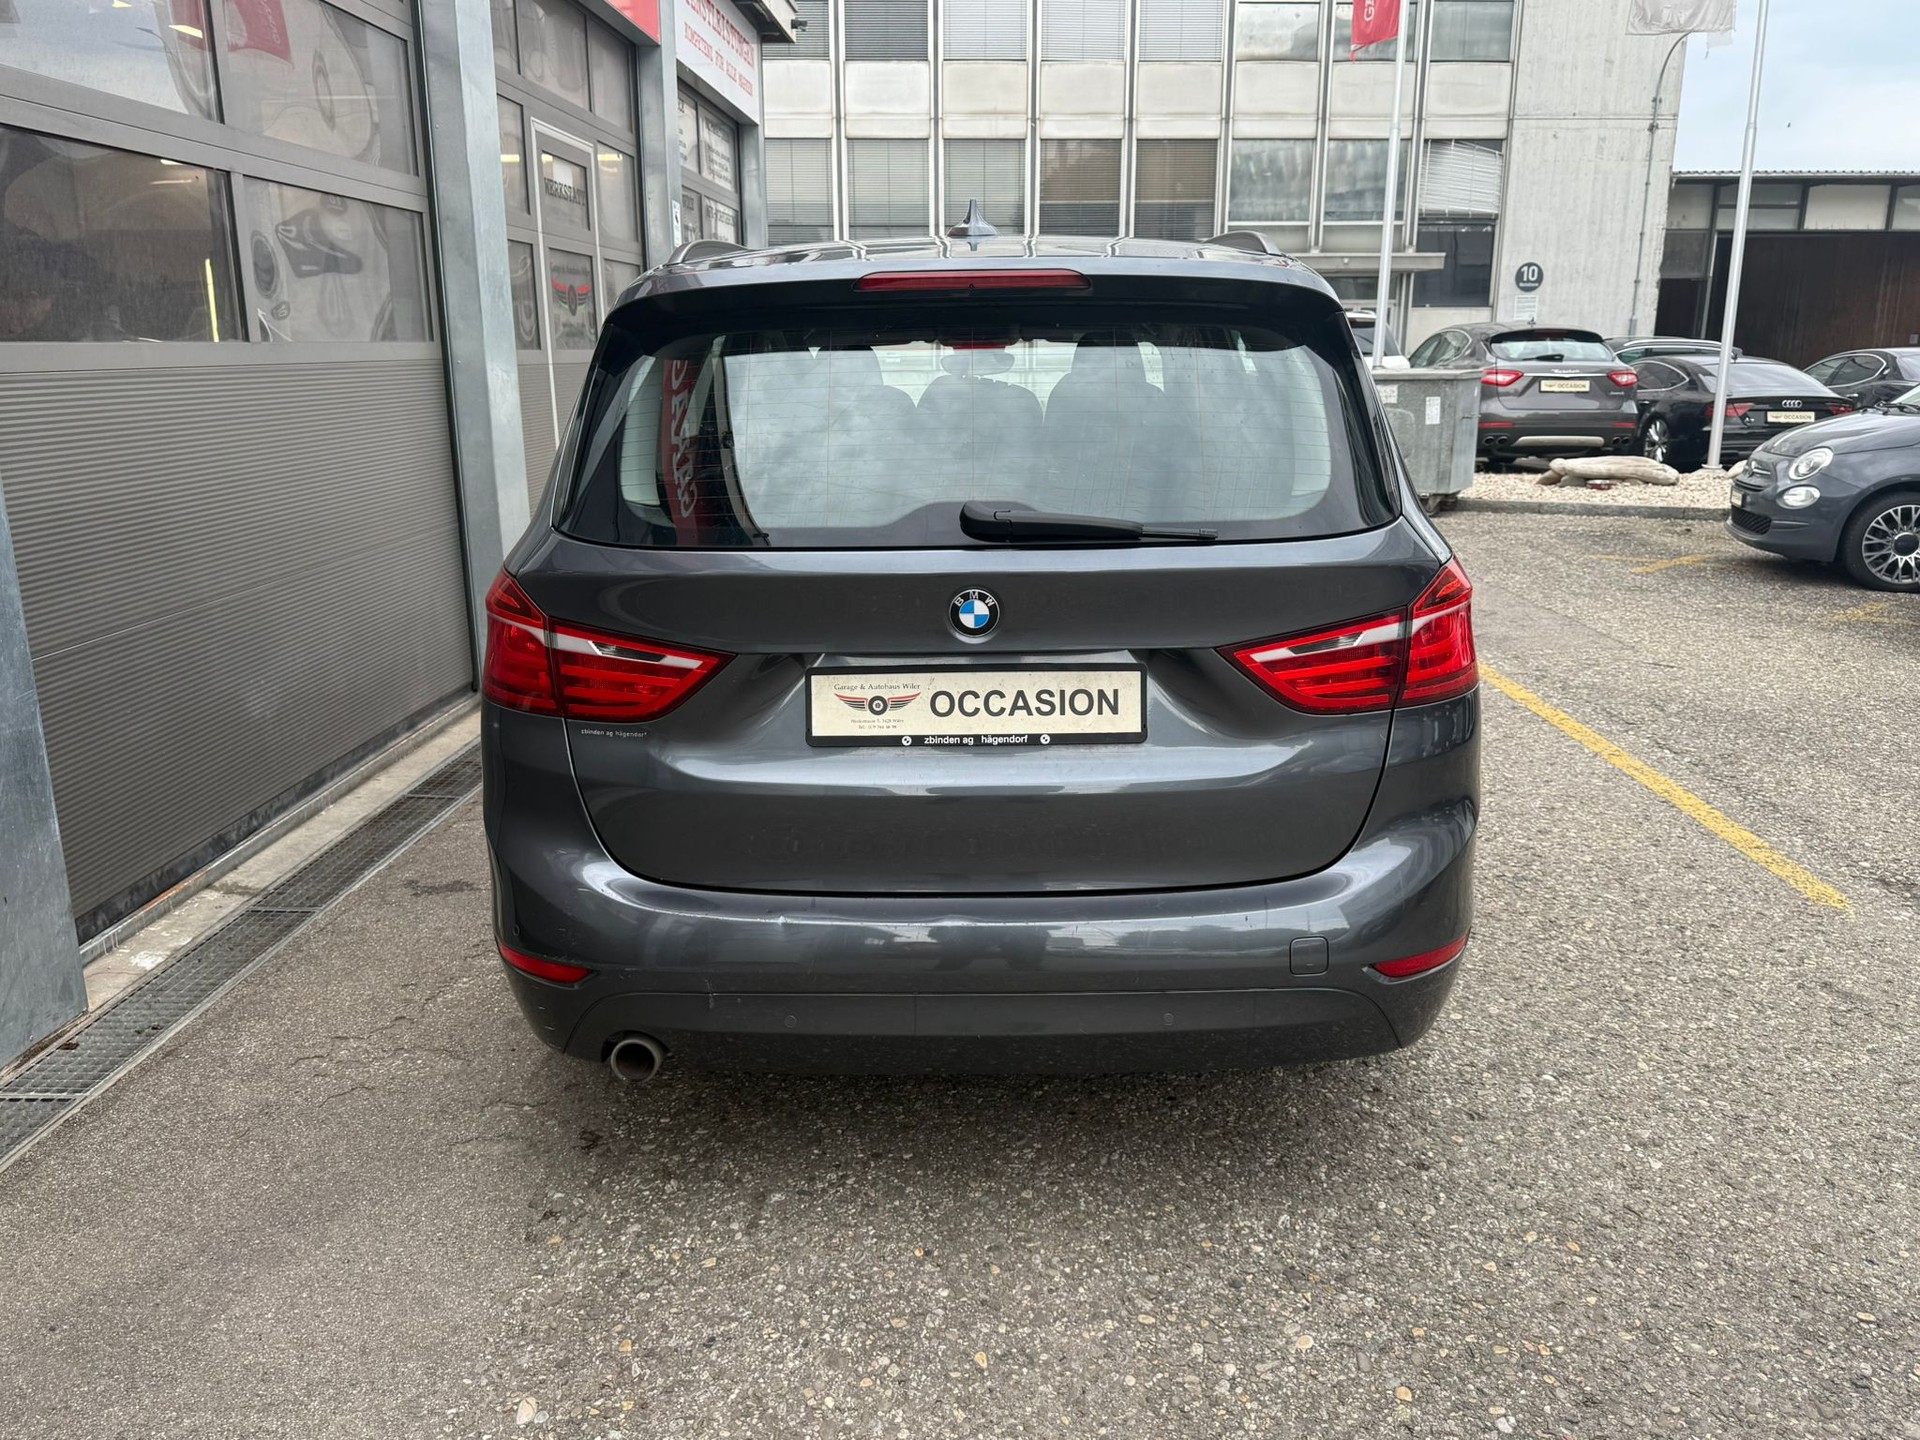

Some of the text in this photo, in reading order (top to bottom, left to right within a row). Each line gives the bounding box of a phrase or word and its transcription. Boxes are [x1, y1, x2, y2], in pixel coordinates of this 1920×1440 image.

[1521, 265, 1539, 281] 10
[954, 591, 995, 607] BMW
[834, 684, 858, 692] Garage
[930, 688, 1119, 718] OCCASION
[924, 735, 1028, 745] zbinden ag hägendorf
